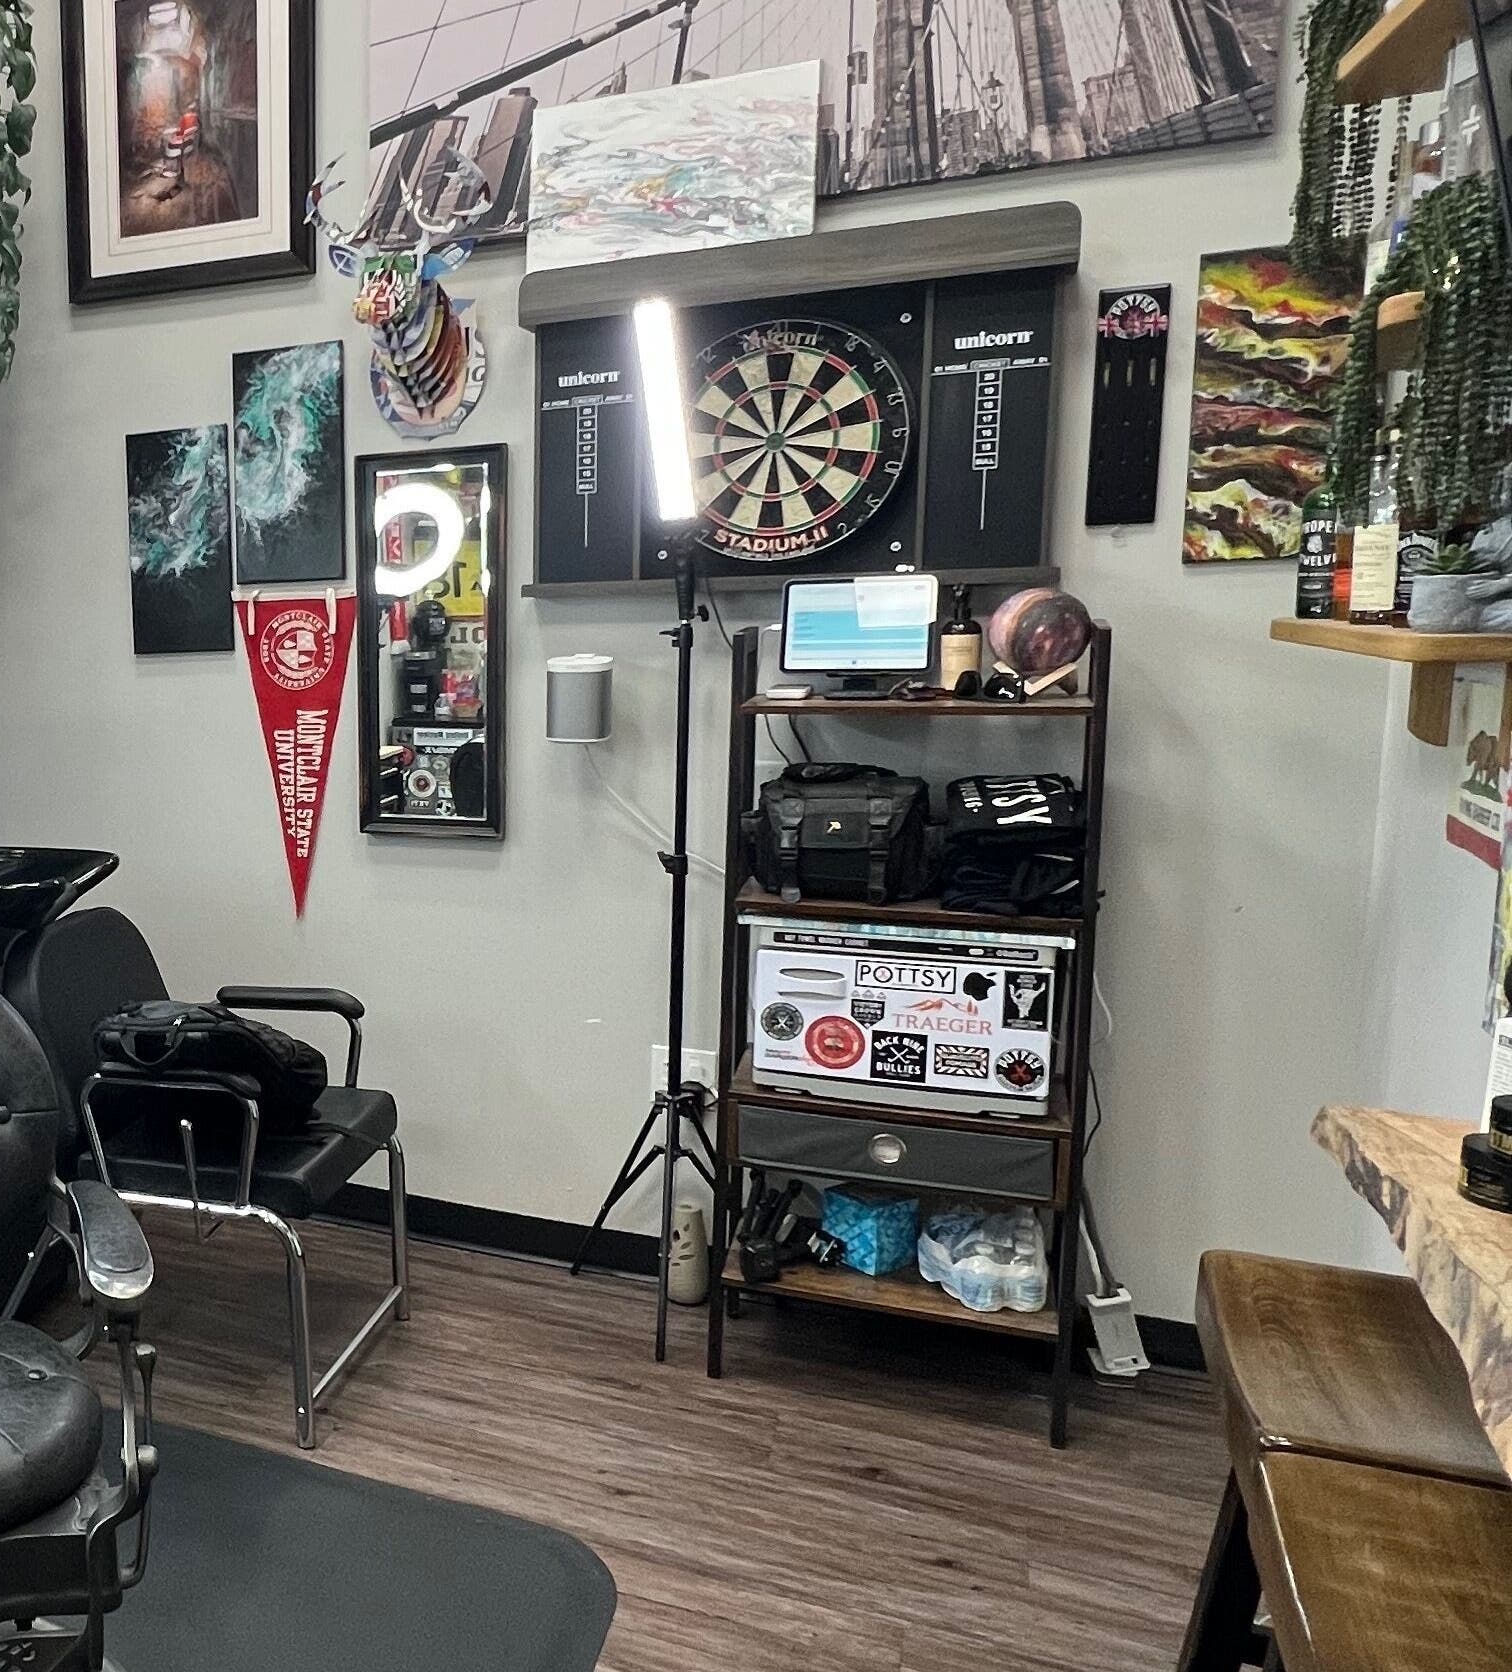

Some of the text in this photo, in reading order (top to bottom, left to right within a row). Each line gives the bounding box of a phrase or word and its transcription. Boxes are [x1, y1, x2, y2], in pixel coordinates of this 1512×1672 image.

[954, 331, 1034, 350] unicorn
[558, 371, 620, 388] unicorn
[714, 526, 829, 552] STADIUM II
[273, 729, 295, 837] UNIVERSITY
[296, 709, 329, 858] MONTCLAIR STATE
[859, 965, 951, 988] POTTSY
[893, 1013, 992, 1035] TRAEGER
[873, 1035, 900, 1050] BACK
[876, 1061, 921, 1075] BULLIES
